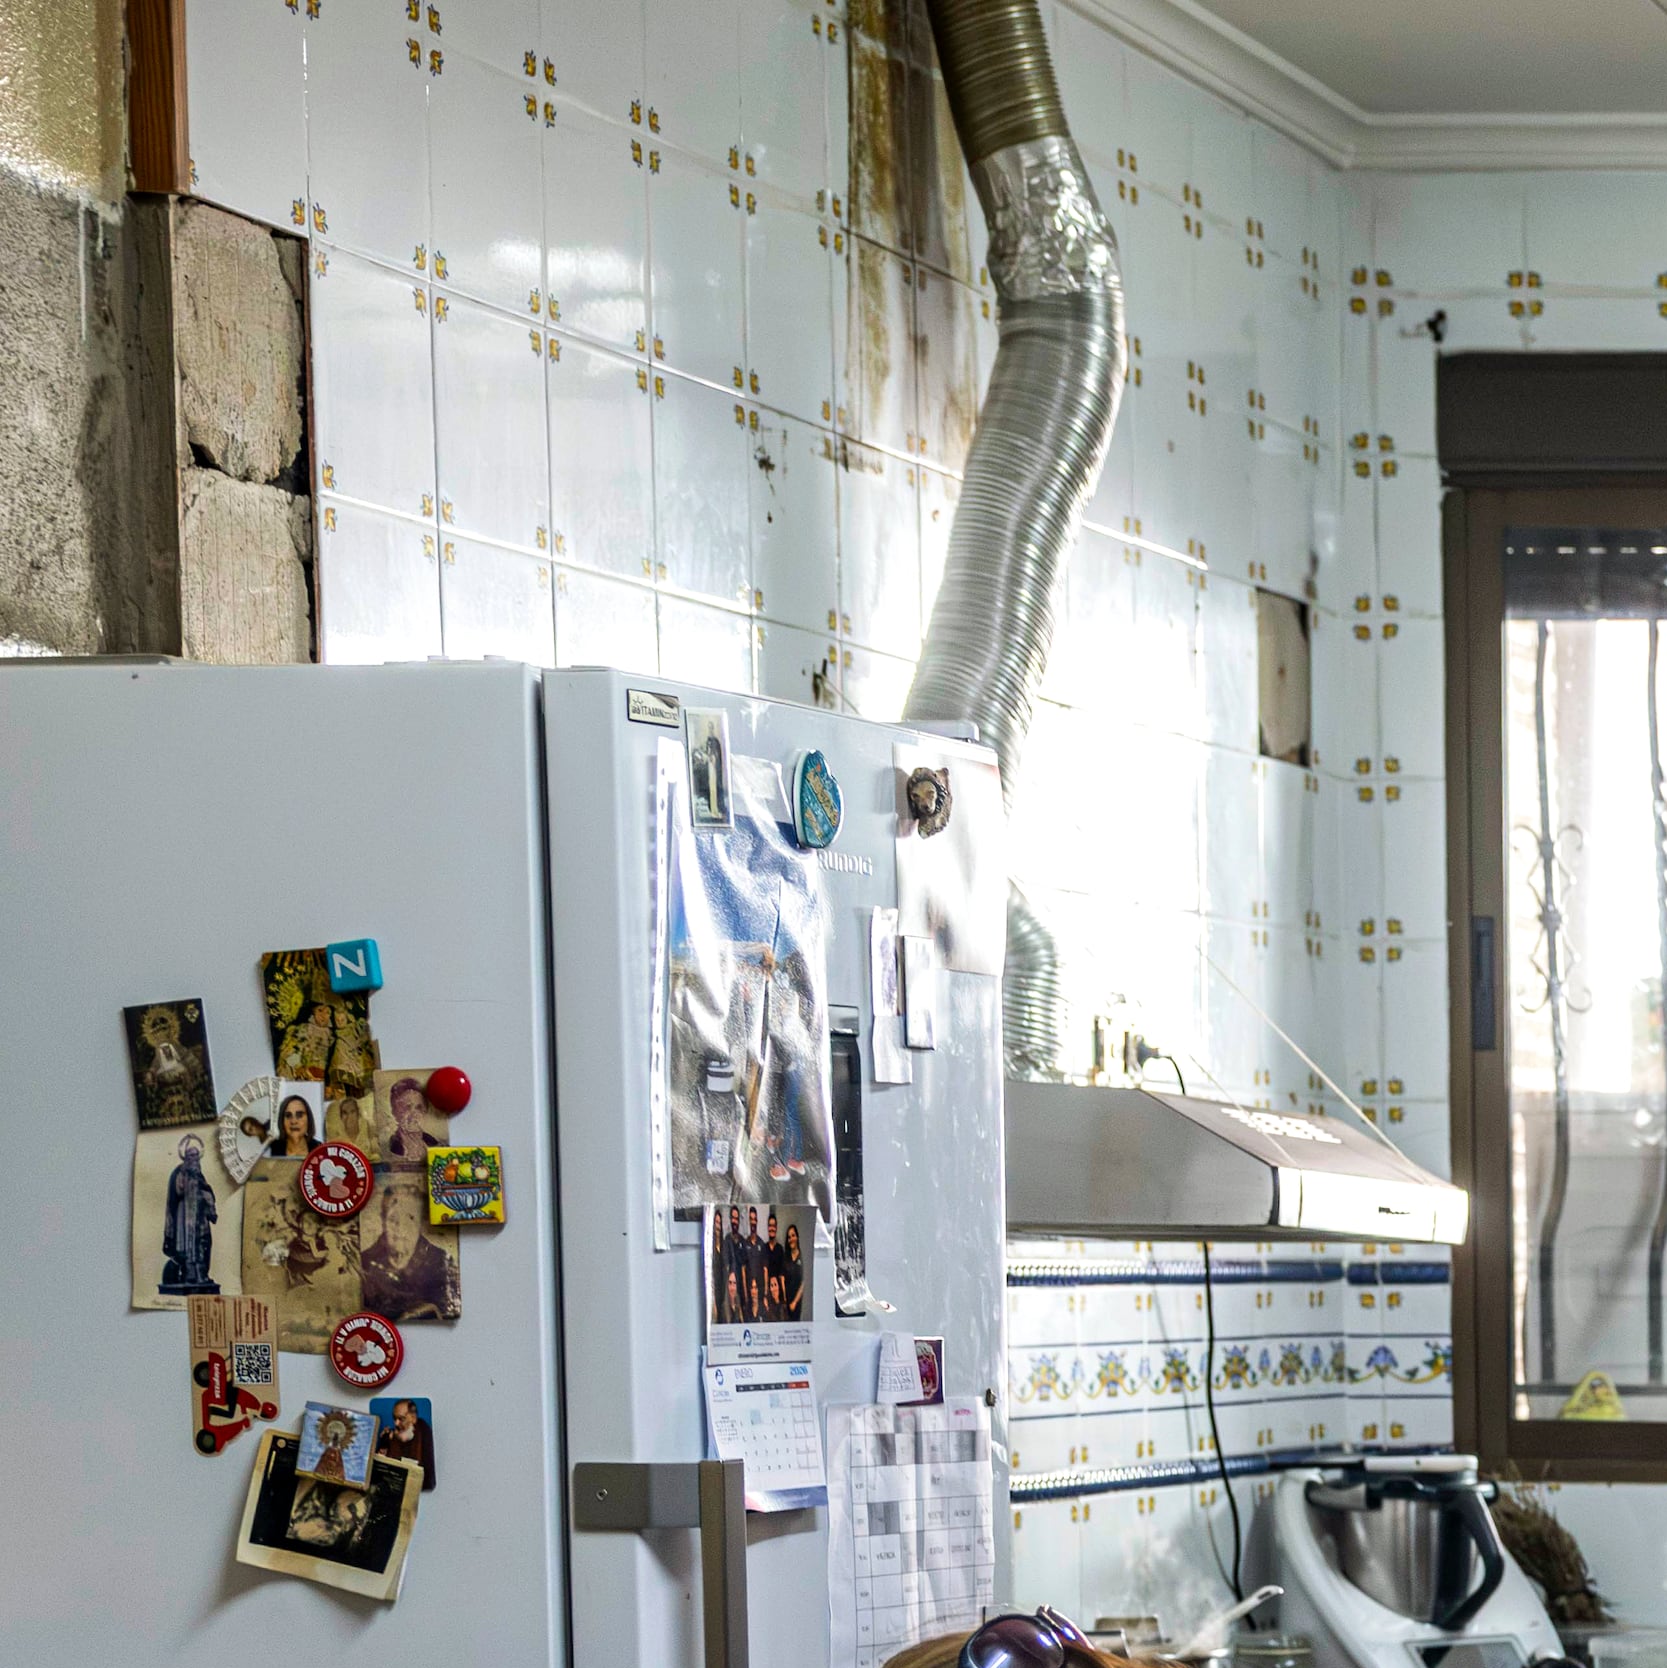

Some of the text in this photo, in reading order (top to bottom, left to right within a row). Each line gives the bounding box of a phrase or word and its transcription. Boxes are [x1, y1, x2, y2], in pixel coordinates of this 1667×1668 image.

[817, 850, 873, 876] RUNDIG
[313, 1197, 338, 1213] JUNTO
[338, 1202, 346, 1212] A
[344, 1198, 354, 1209] TI
